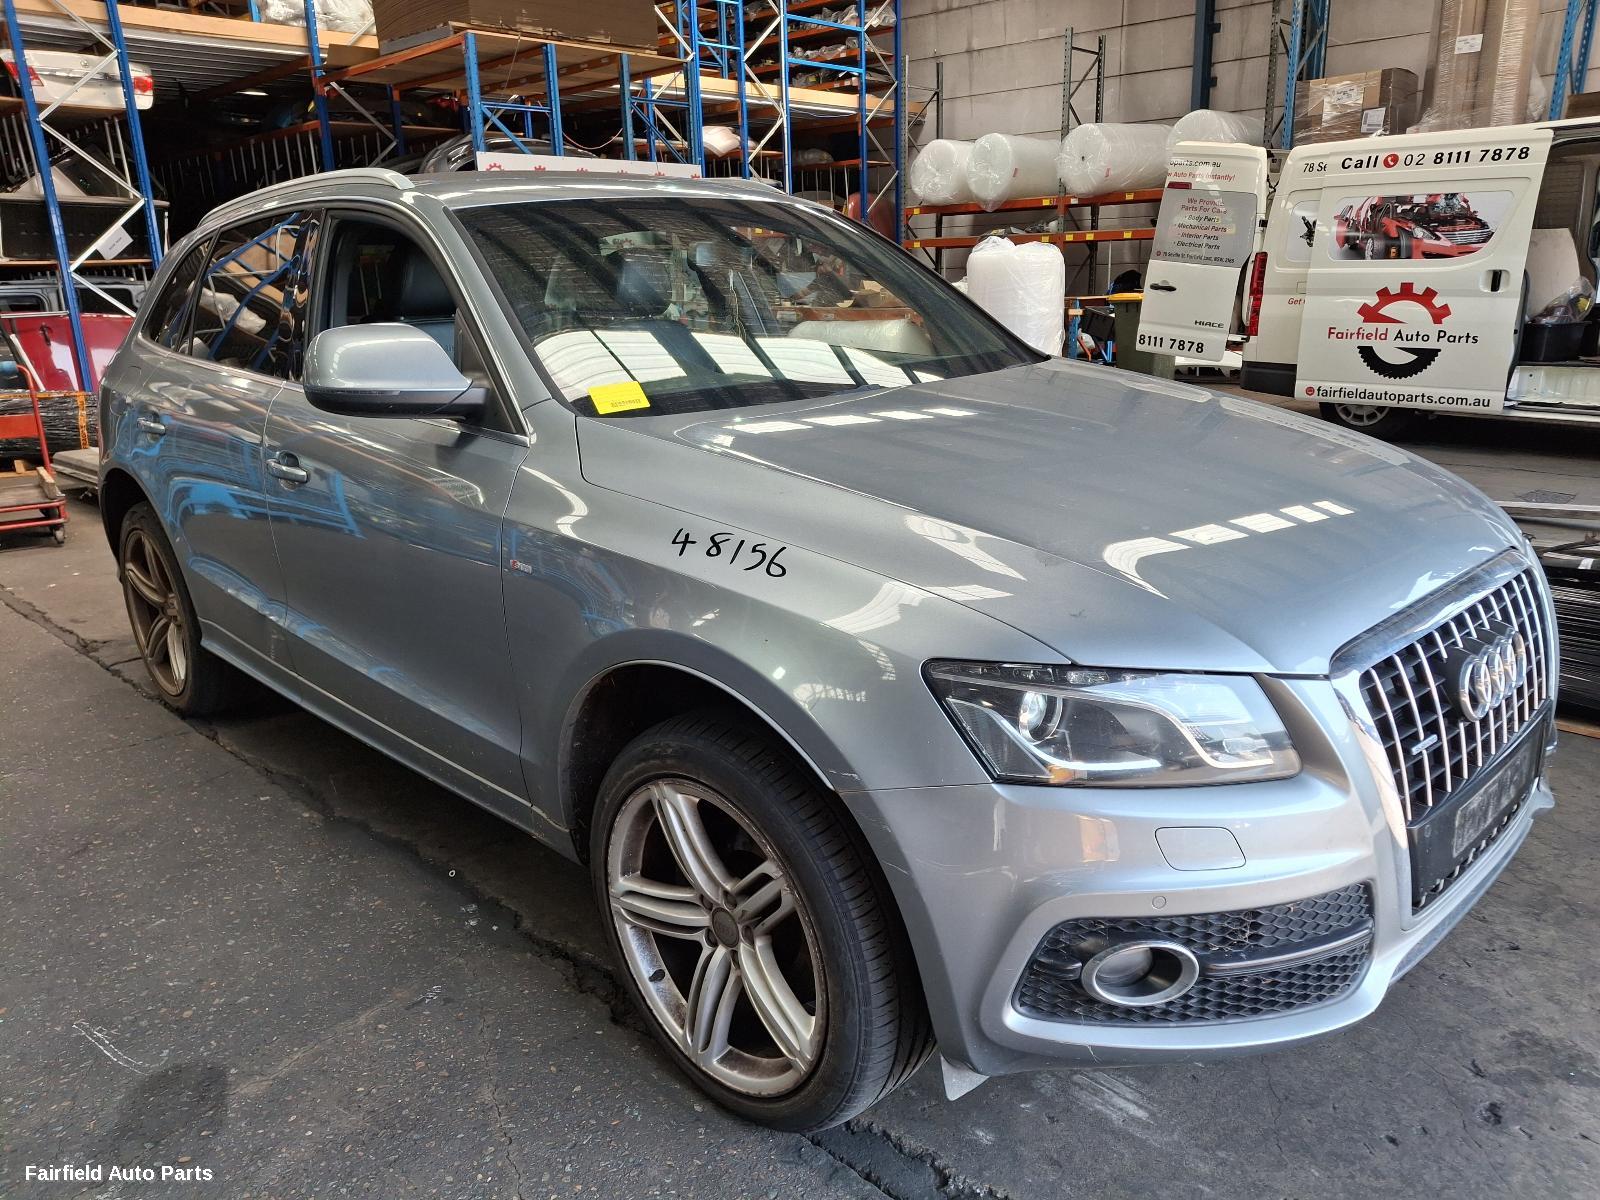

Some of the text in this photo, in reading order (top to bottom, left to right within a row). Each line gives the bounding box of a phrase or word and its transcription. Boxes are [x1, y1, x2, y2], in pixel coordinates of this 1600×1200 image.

[1341, 147, 1530, 169] Call 02 8111 7878
[1303, 163, 1315, 173] 78
[1187, 197, 1198, 205] We
[1181, 204, 1198, 212] Parts
[1187, 214, 1203, 223] Body
[1177, 222, 1228, 233] Mechanical Parts
[1180, 232, 1202, 240] Interior
[1176, 240, 1221, 251] Electrical Parts
[1194, 320, 1224, 329] HIACE
[1327, 326, 1479, 344] Fairfield Auto Parts
[1138, 334, 1204, 354] 8111 7878
[1316, 385, 1491, 408] fairfieldautoparts.com.au
